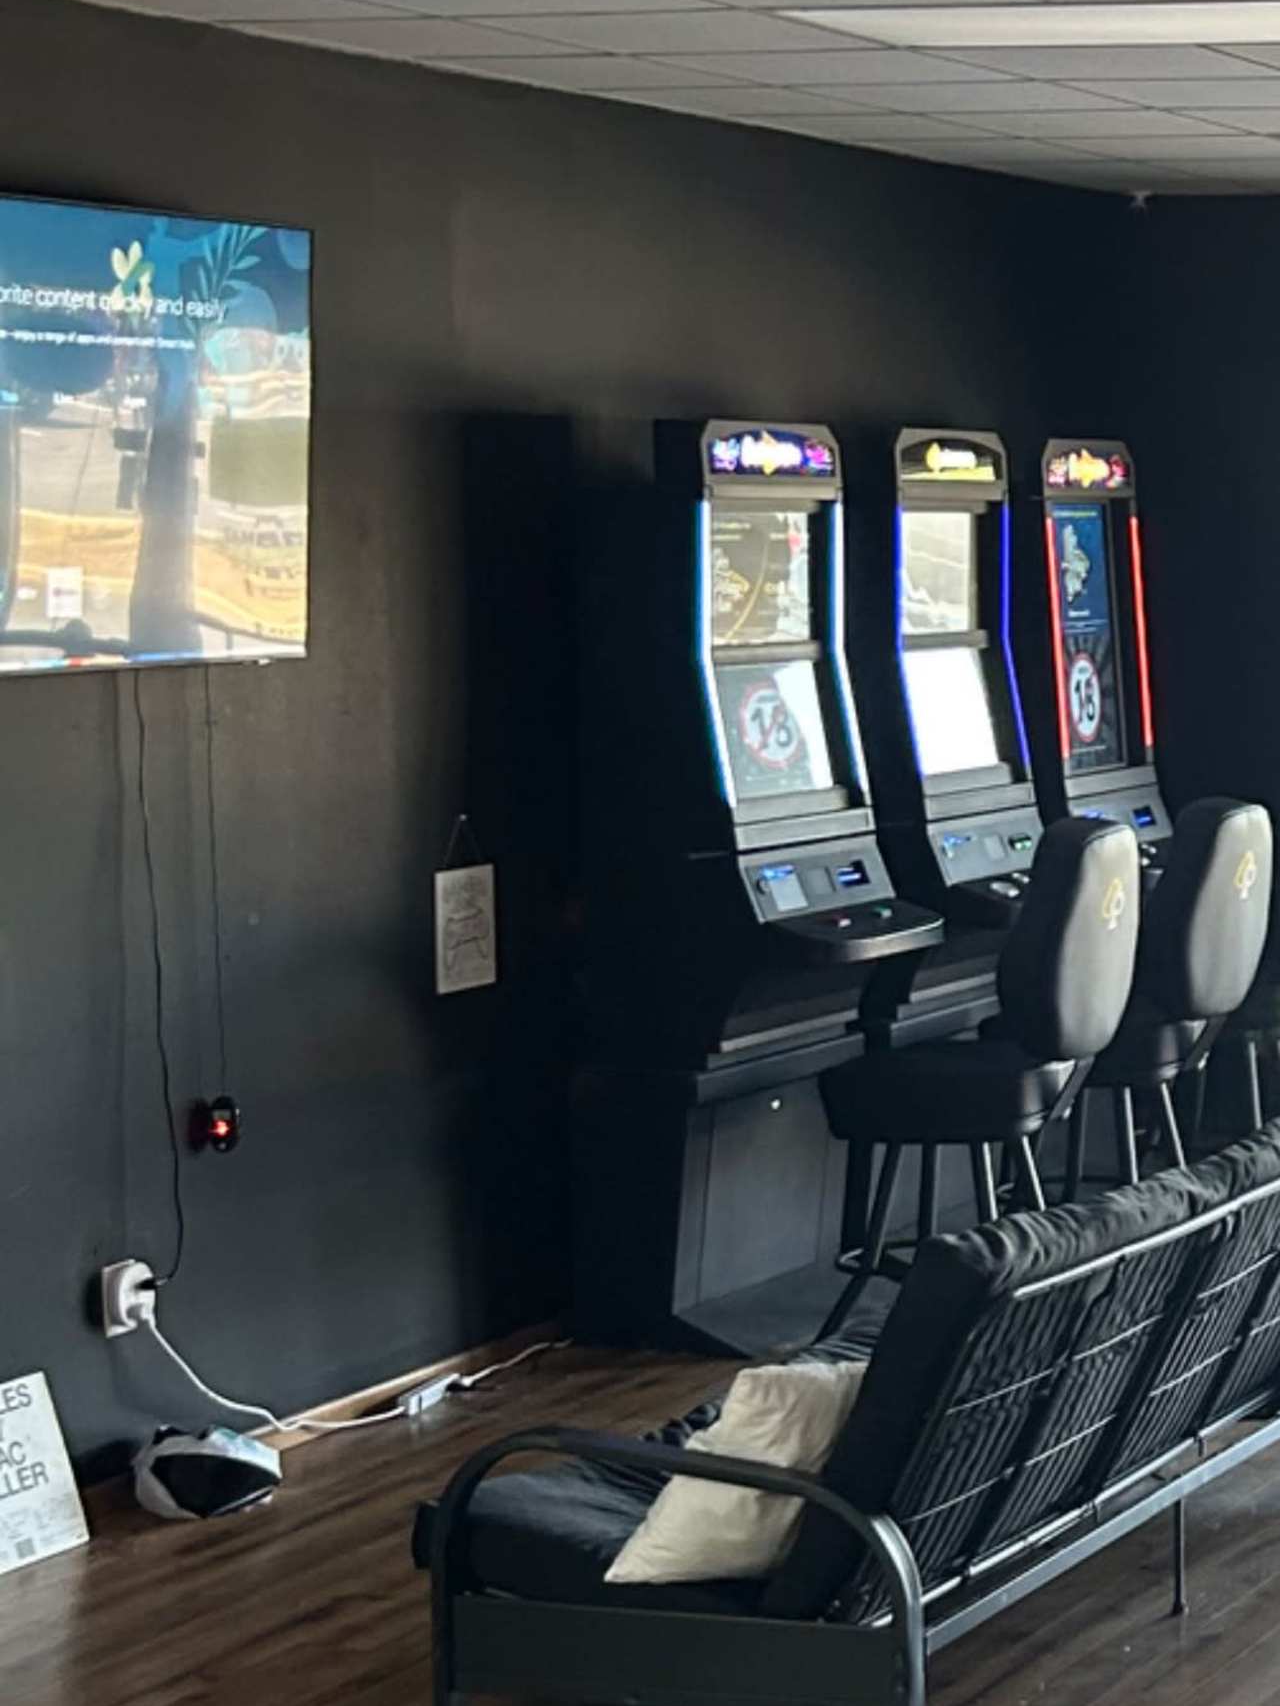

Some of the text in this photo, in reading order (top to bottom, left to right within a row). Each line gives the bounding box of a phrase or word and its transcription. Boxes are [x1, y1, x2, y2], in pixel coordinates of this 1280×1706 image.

[35, 287, 96, 310] content
[155, 296, 183, 315] and
[186, 301, 225, 323] easily
[0, 1461, 49, 1499] LER
